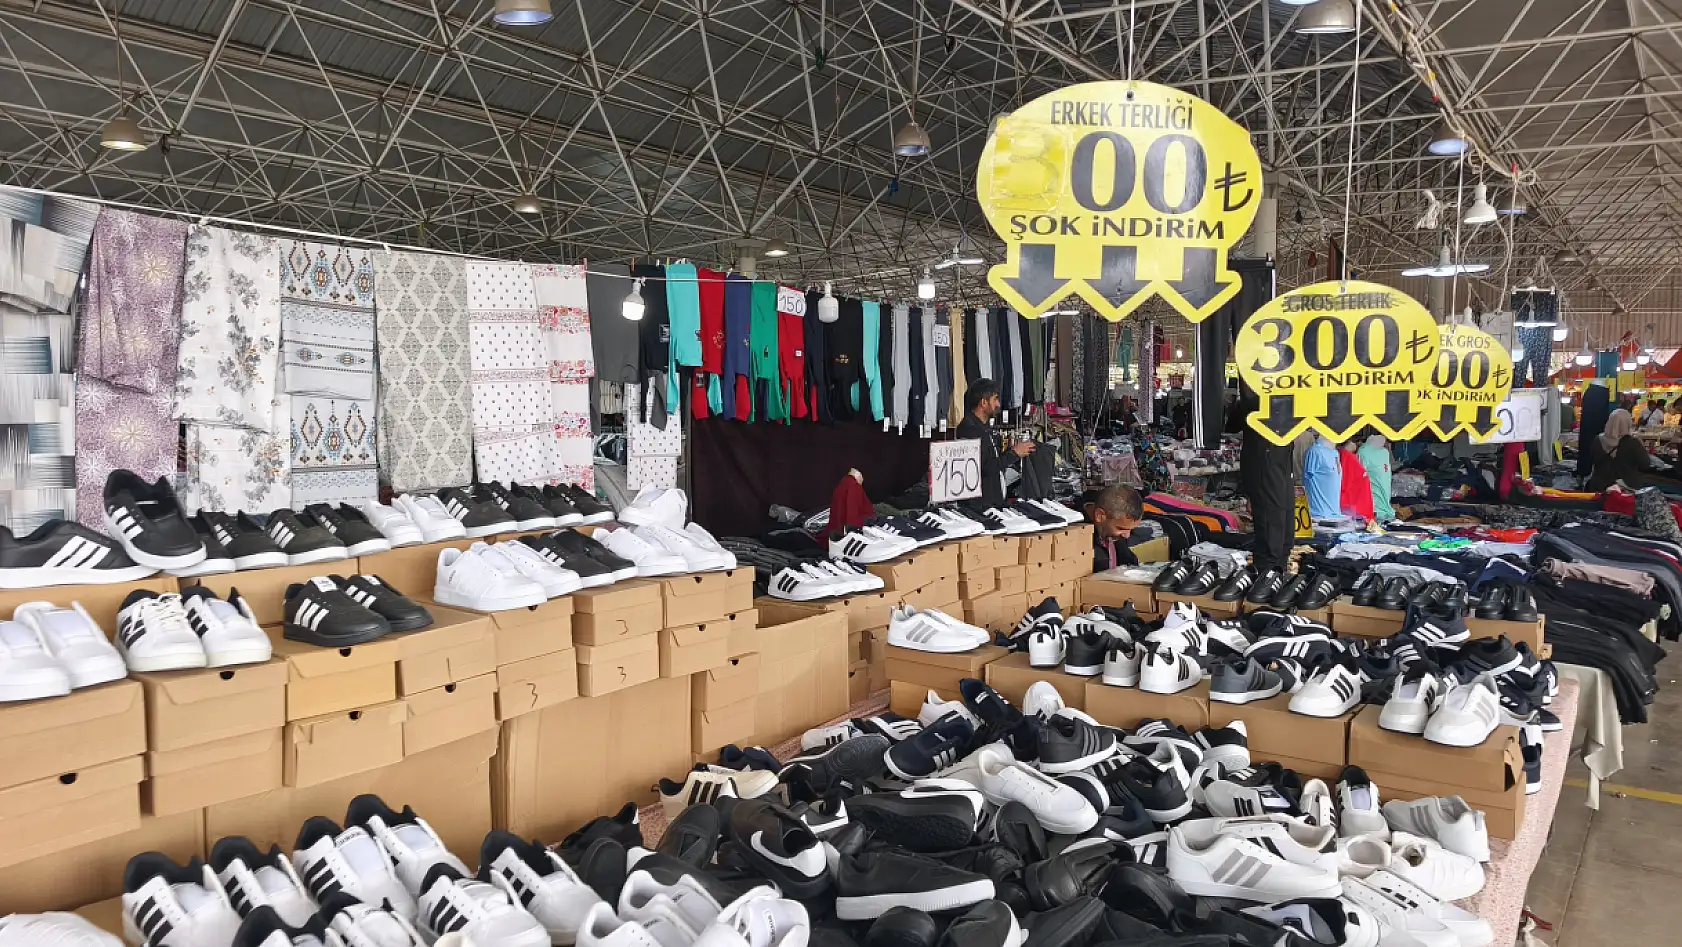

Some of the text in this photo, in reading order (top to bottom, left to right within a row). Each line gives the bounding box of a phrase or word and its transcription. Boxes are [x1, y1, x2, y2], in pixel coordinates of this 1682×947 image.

[1050, 100, 1113, 126] ERKEK
[1010, 214, 1082, 241] ŞOK
[779, 294, 804, 314] 150
[1457, 334, 1491, 349] GROS
[1261, 372, 1313, 394] ŞOK
[937, 457, 980, 499] 150
